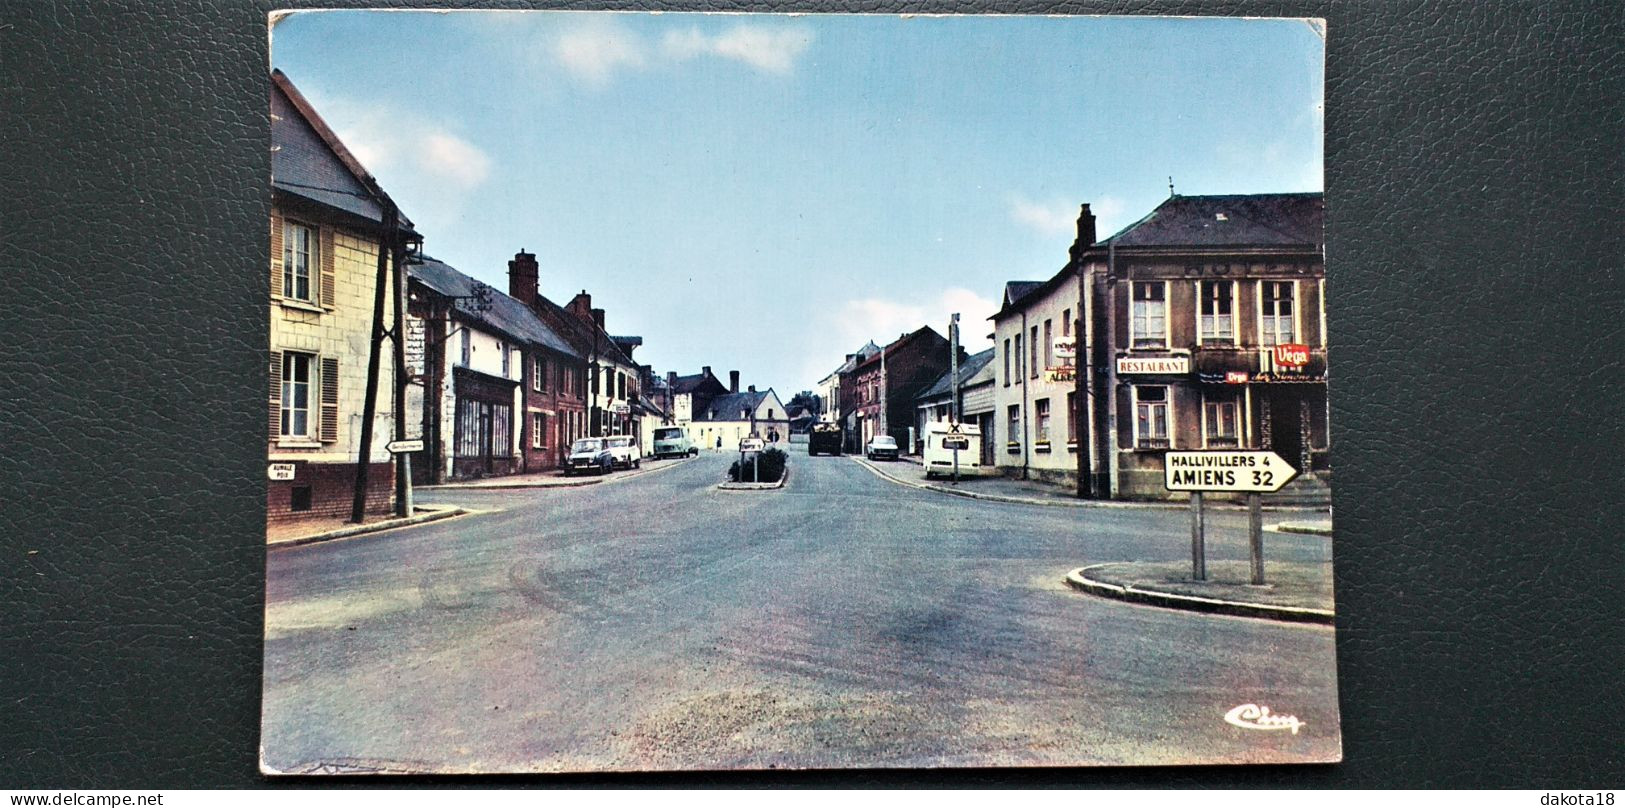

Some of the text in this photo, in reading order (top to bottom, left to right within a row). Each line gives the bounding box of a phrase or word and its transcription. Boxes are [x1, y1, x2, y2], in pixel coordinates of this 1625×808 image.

[1120, 361, 1185, 372] RESTAURANT
[1171, 456, 1270, 467] HALLIVILLERS 4
[1172, 470, 1274, 486] AMIENS 32
